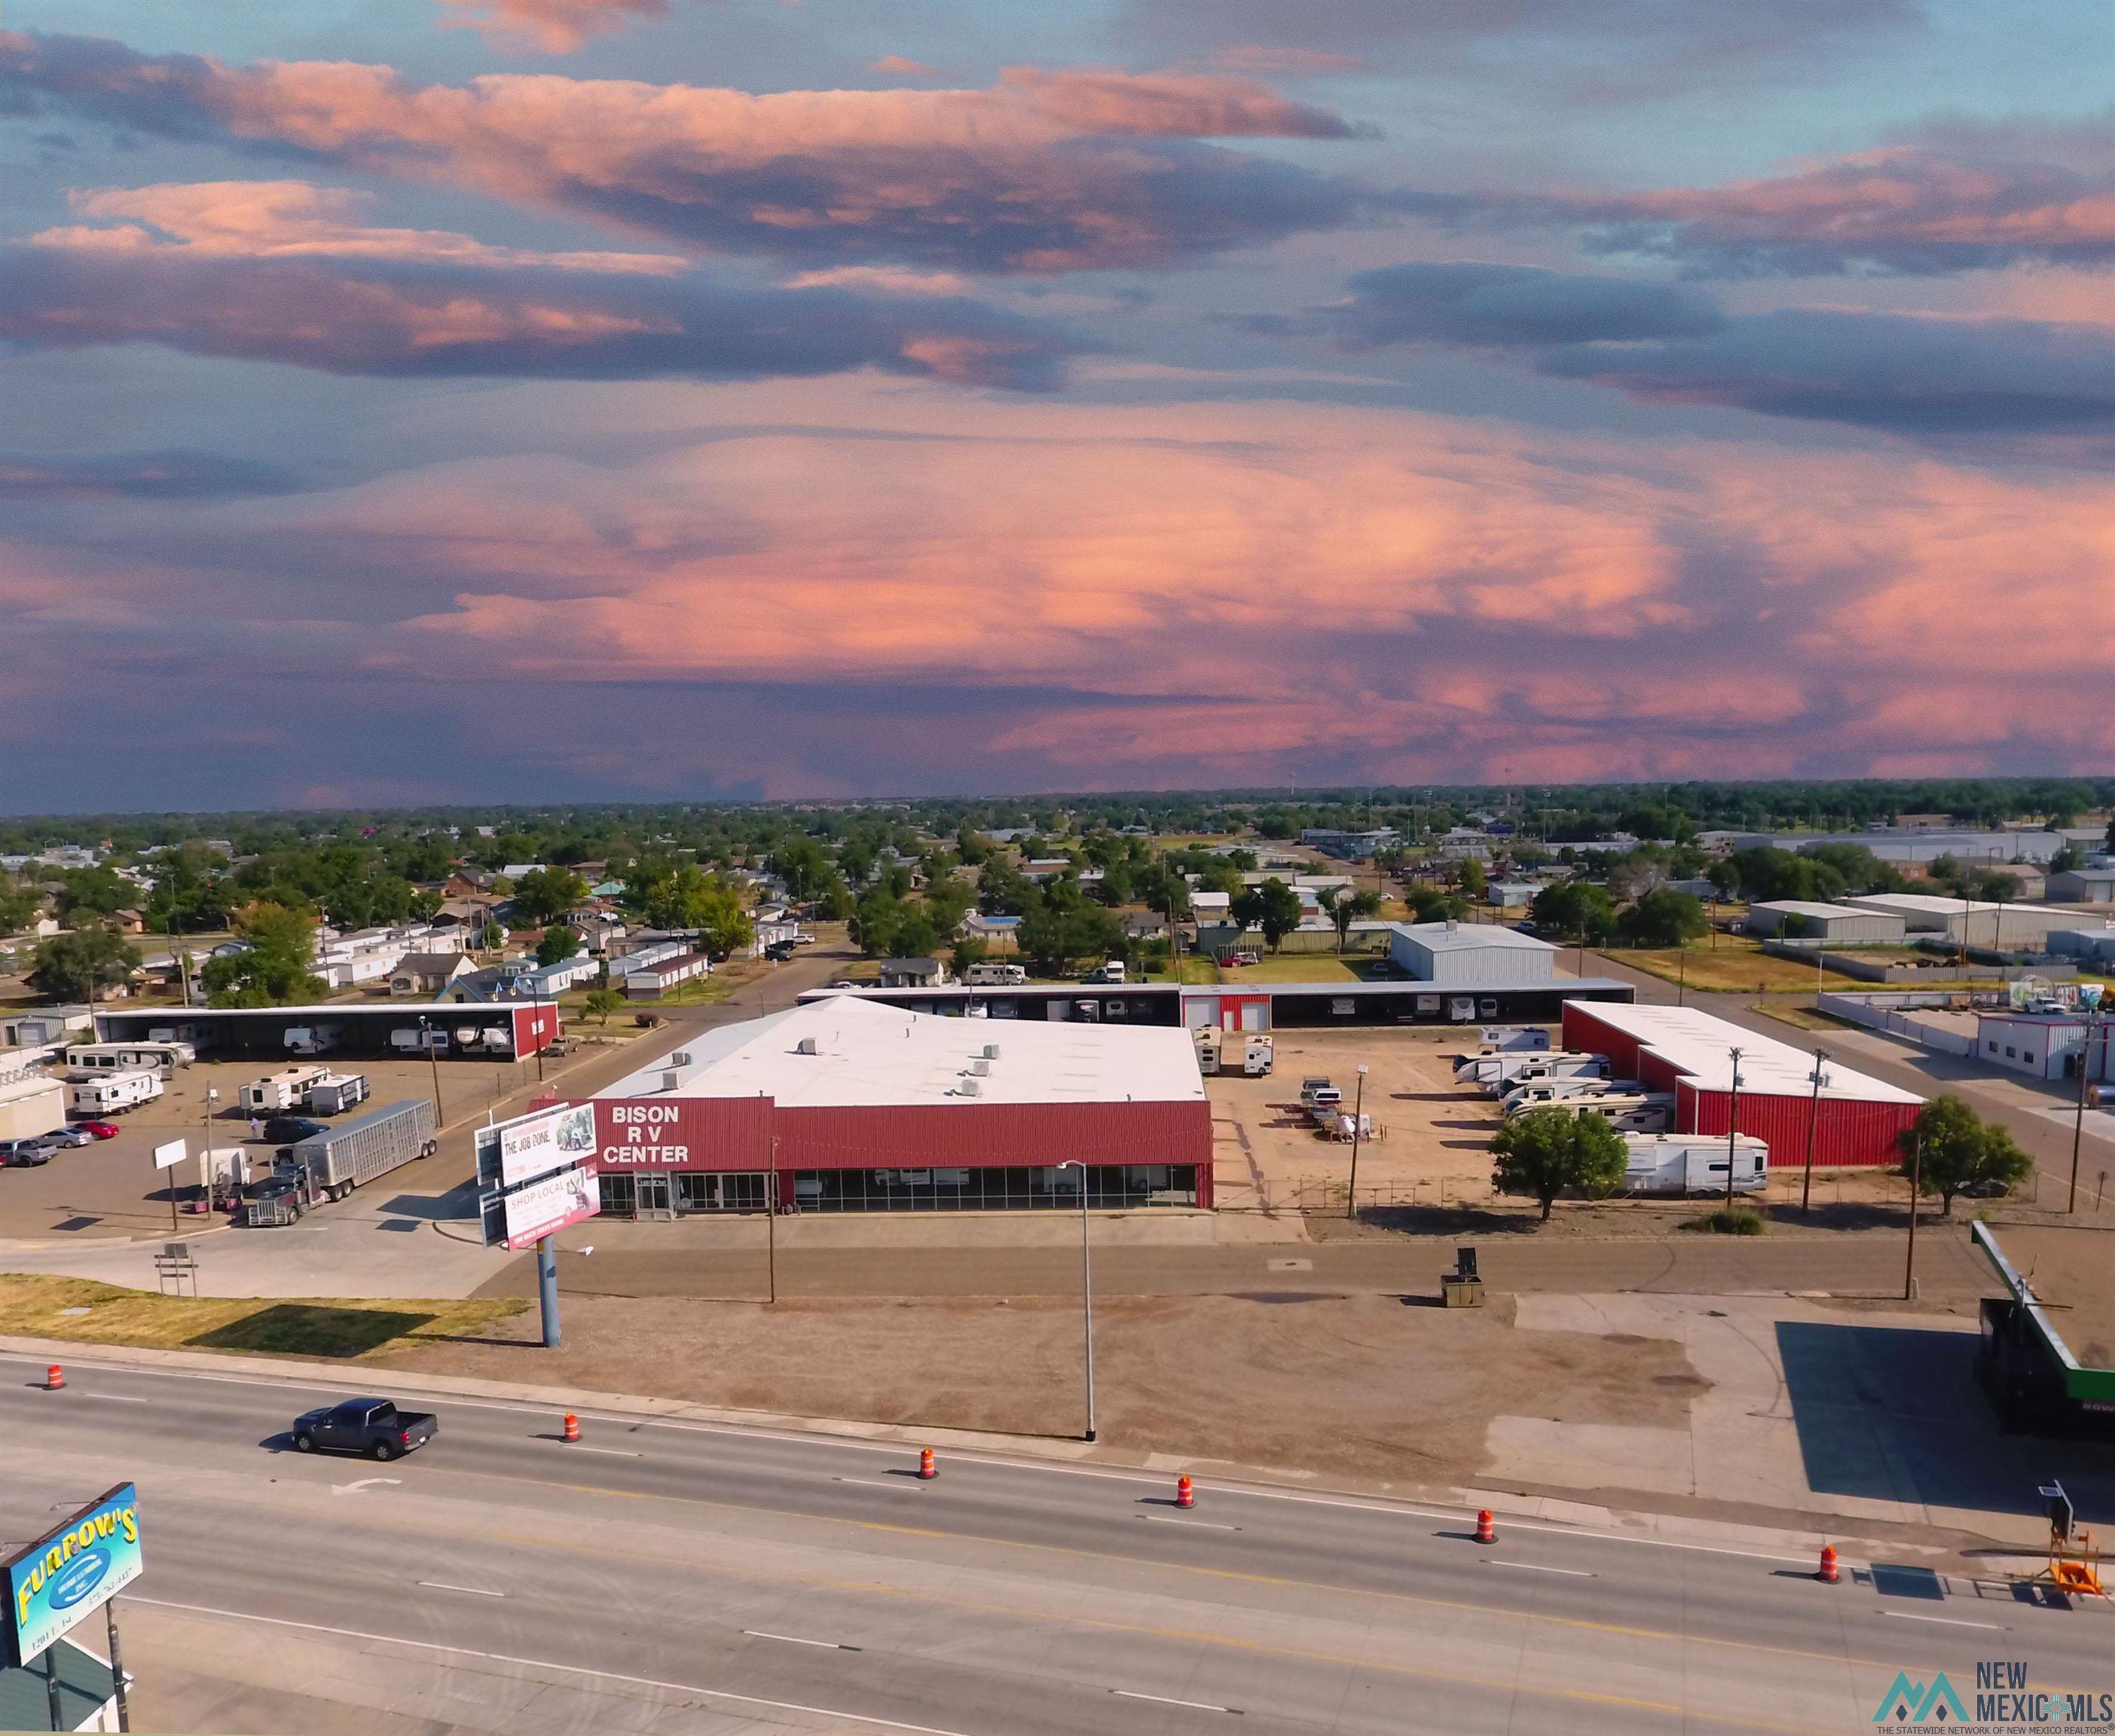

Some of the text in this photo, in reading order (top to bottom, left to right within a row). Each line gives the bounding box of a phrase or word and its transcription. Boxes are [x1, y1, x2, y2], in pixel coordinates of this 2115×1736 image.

[613, 1106, 678, 1123] BISON
[505, 1141, 518, 1157] THE
[519, 1136, 530, 1152] JOB
[533, 1130, 551, 1146] DONE.
[628, 1126, 662, 1143] R V
[603, 1146, 688, 1163] CENTER
[512, 1192, 536, 1210] SHOP
[538, 1181, 564, 1199] LOCAL
[17, 1508, 136, 1628] FURROW'S
